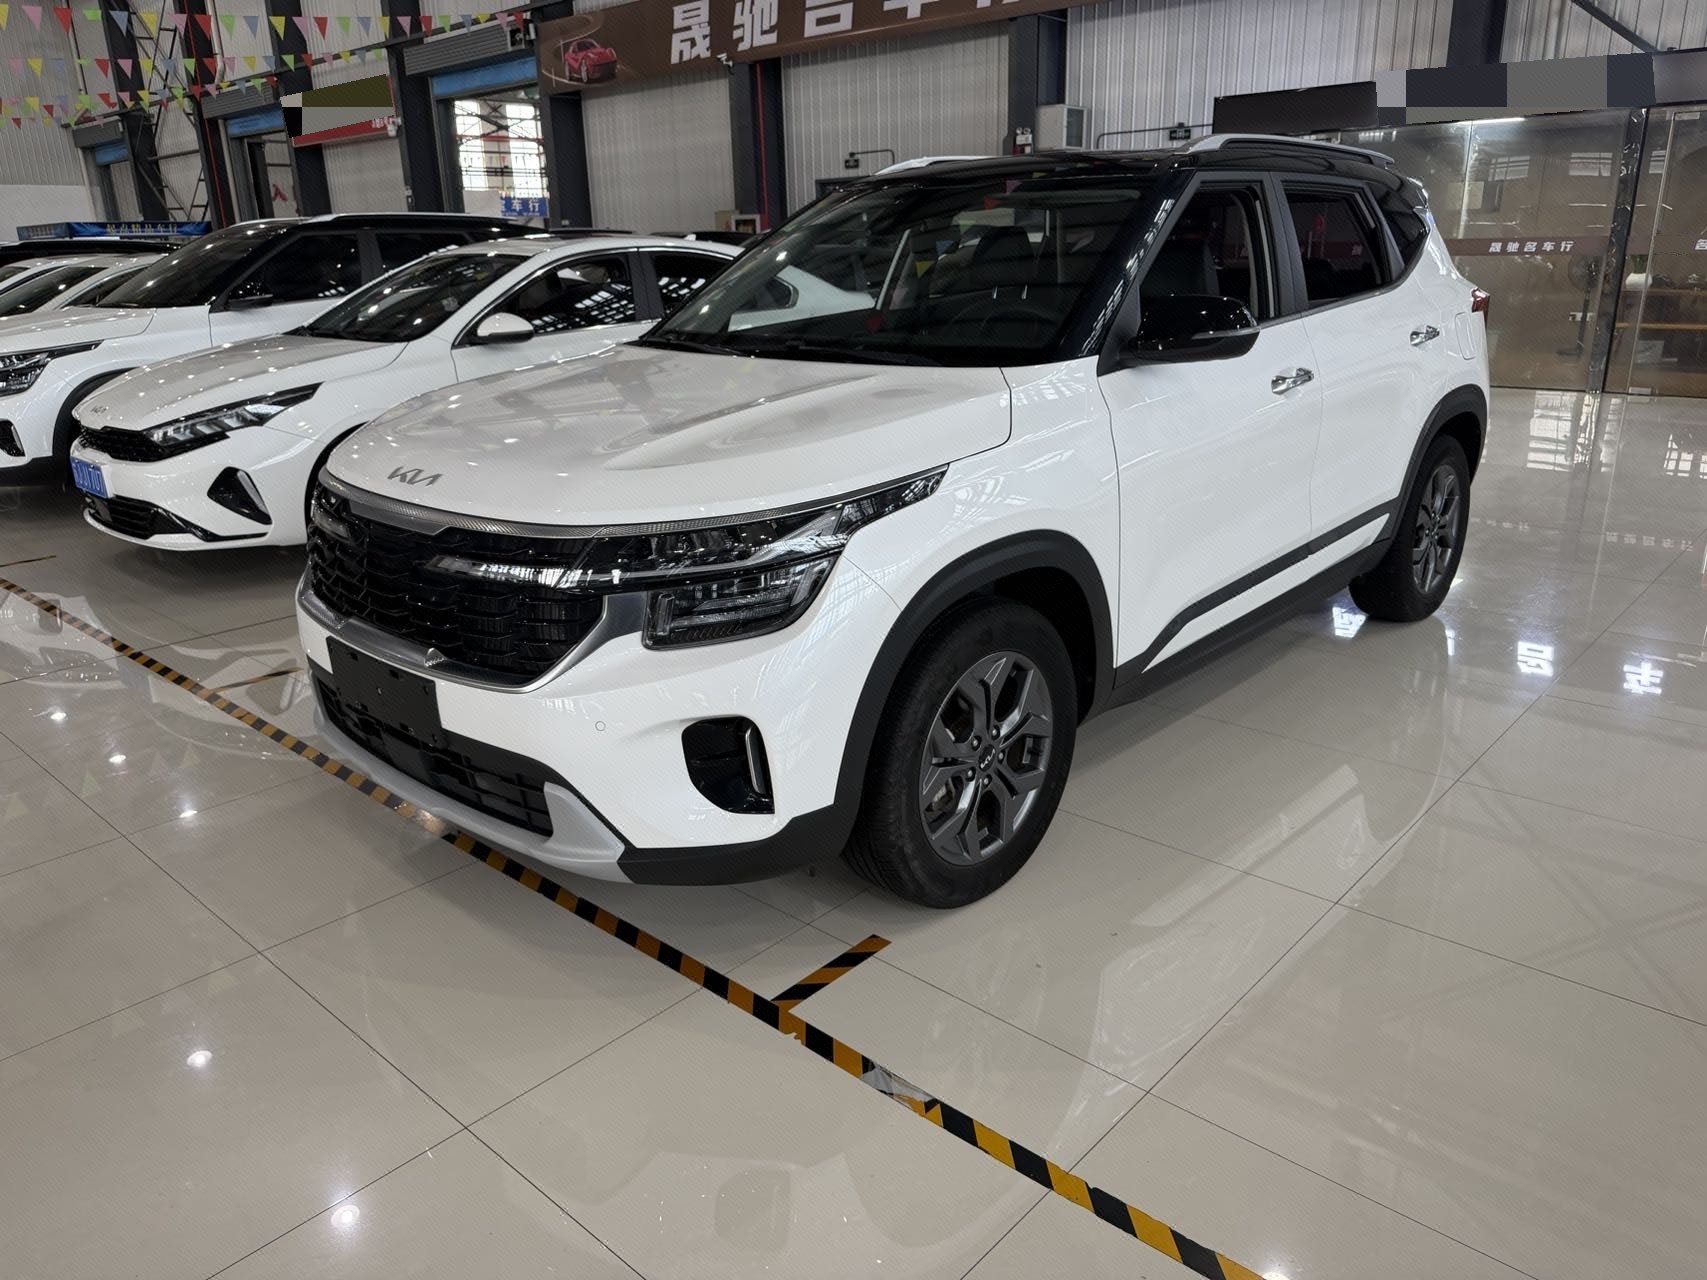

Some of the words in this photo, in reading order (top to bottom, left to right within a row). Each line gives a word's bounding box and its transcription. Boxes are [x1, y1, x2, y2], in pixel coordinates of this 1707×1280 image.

[1488, 240, 1575, 253] 晟驰名车行
[387, 466, 443, 486] KIA
